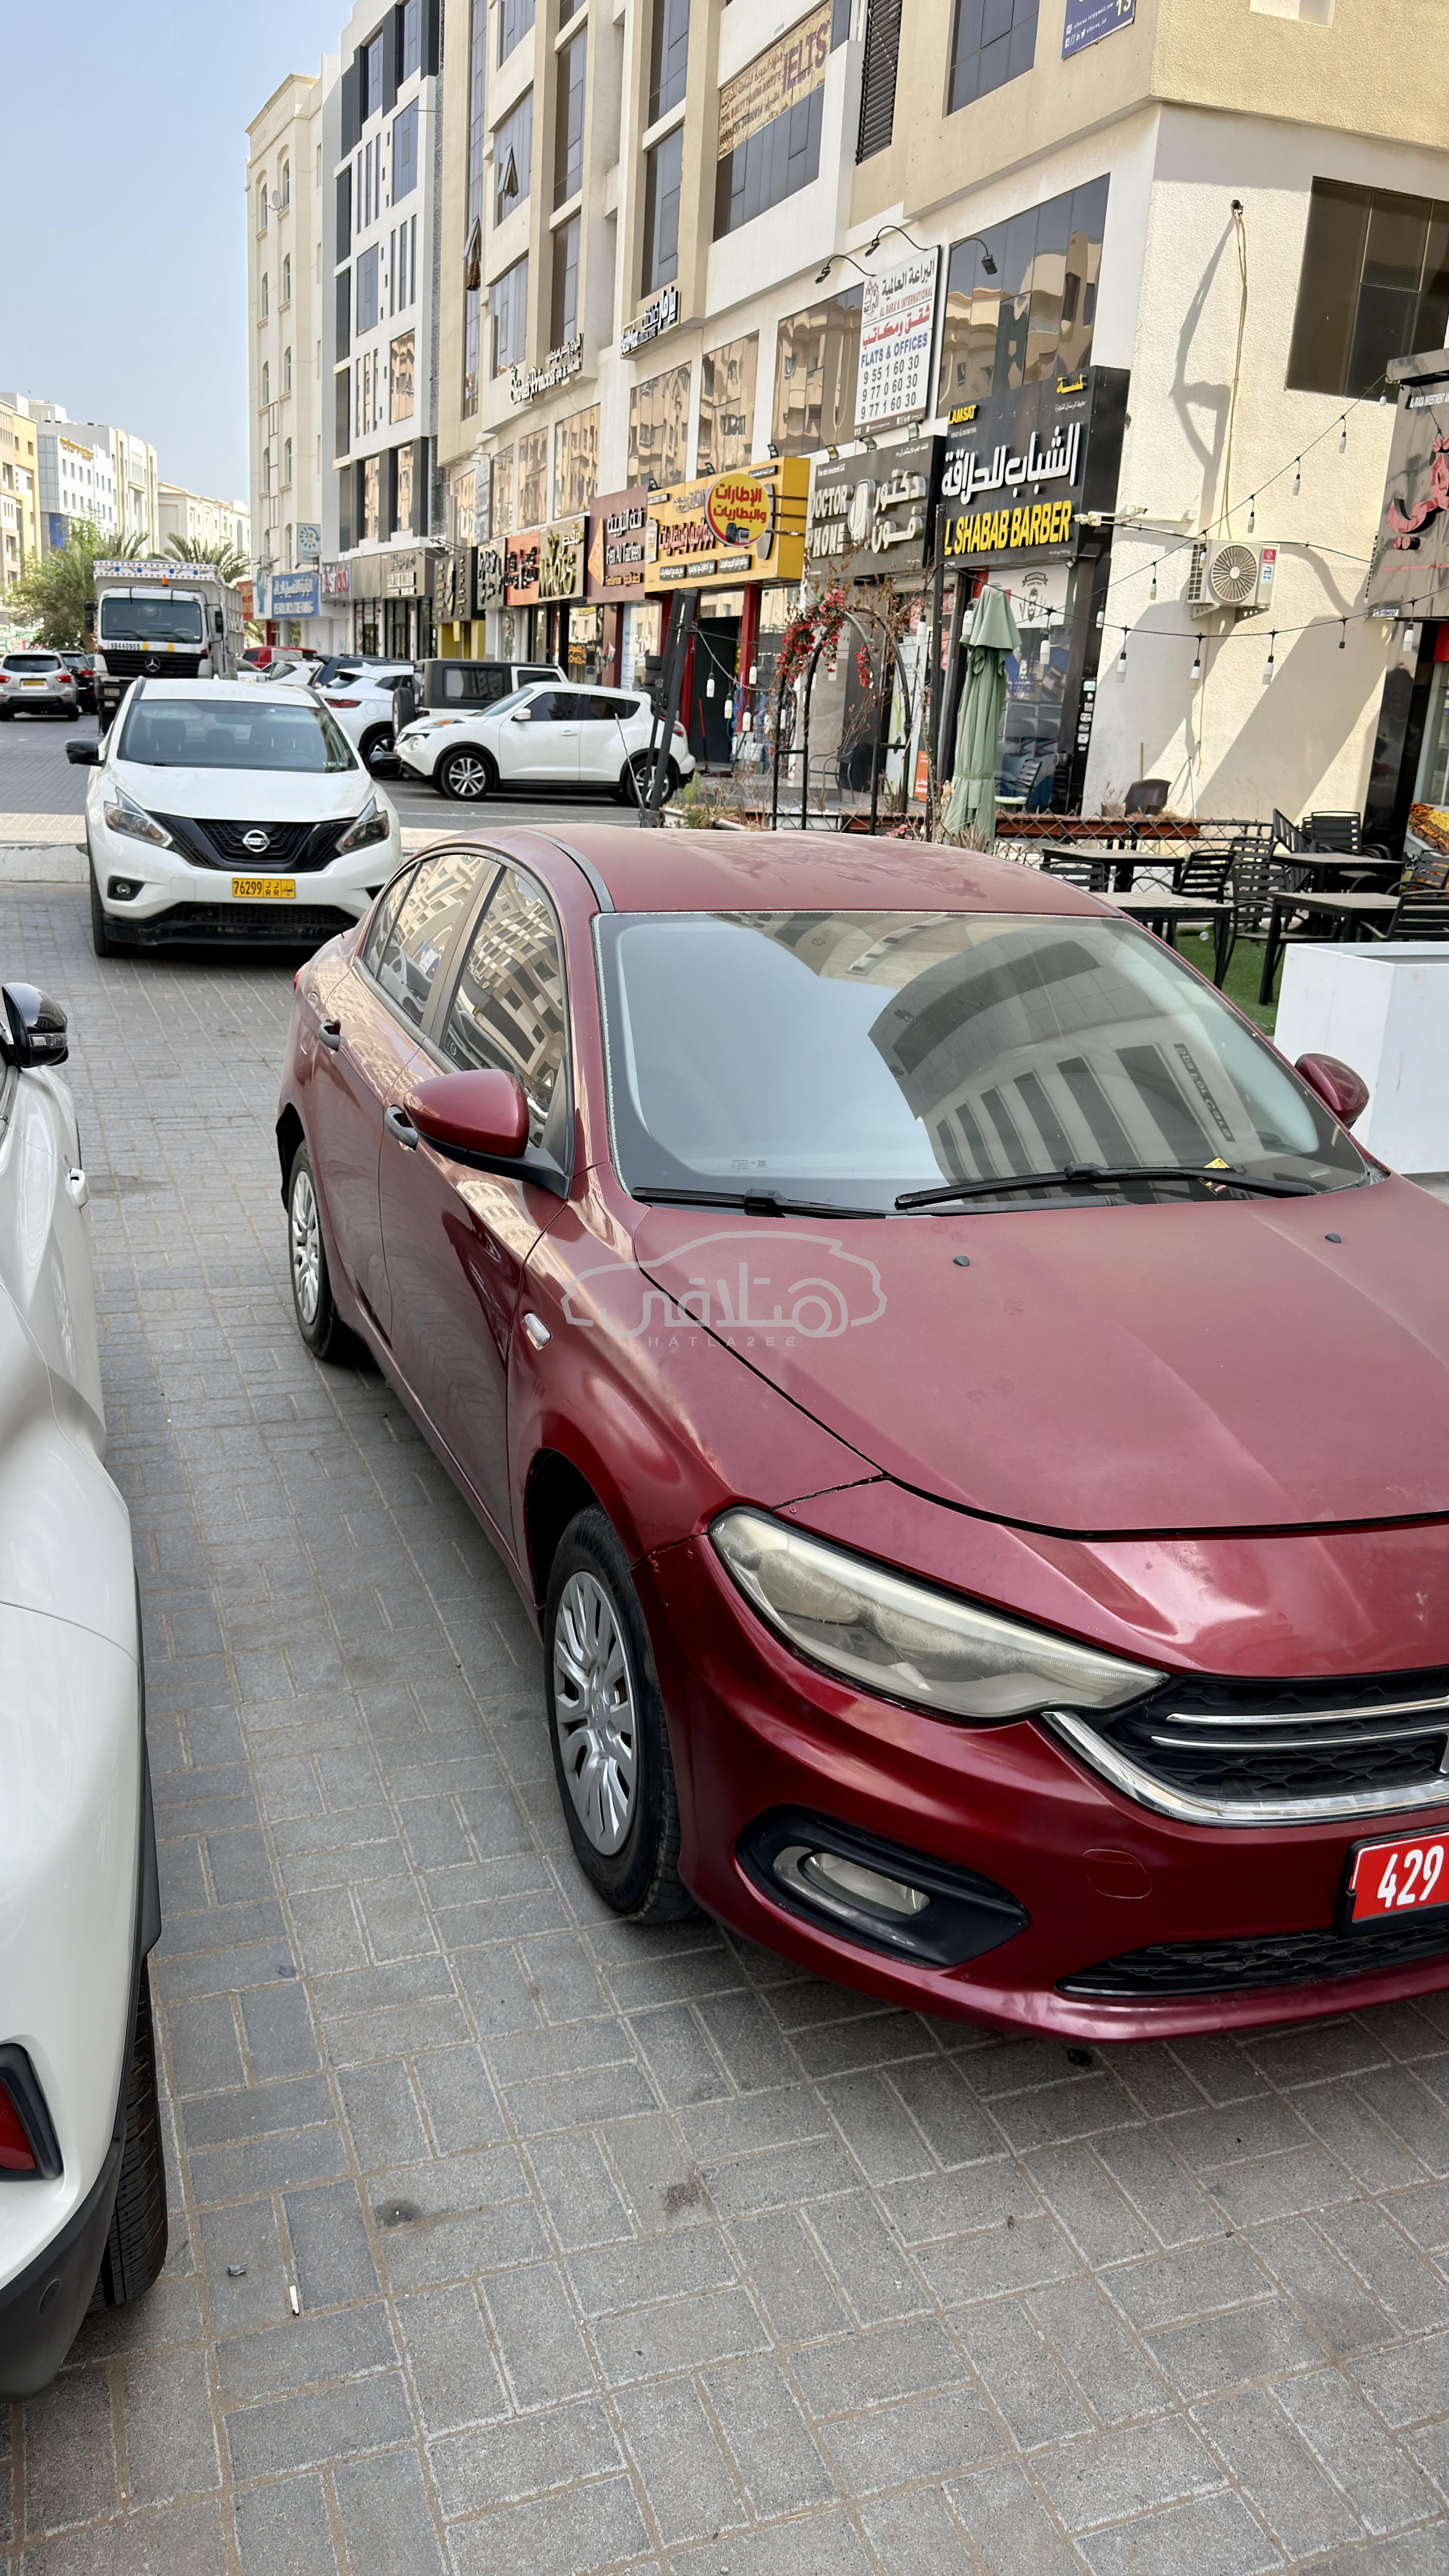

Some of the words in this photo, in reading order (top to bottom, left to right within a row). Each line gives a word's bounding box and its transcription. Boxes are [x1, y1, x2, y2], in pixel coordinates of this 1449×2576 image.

[781, 22, 829, 95] IELTS
[901, 285, 933, 309] INTERNATIONAL
[905, 304, 930, 334] شقق
[861, 348, 884, 368] FLATS
[886, 345, 891, 359] &
[894, 332, 928, 357] OFFICES
[863, 321, 903, 350] ومكاتب
[864, 372, 868, 385] 9
[872, 367, 882, 382] 55
[886, 364, 889, 377] 1
[894, 359, 904, 375] 60
[908, 354, 919, 371] 30
[1056, 373, 1085, 393] لمسة
[862, 389, 867, 402] 9
[871, 385, 881, 400] 77
[884, 382, 888, 395] 0
[892, 378, 902, 393] 60
[907, 373, 917, 389] 30
[1425, 393, 1445, 407] INVESTMENT
[861, 407, 865, 419] 9
[869, 402, 879, 417] 77
[883, 400, 887, 413] 1
[891, 396, 901, 411] 60
[905, 392, 916, 407] 30
[948, 404, 976, 425] LAMSAT
[942, 445, 1007, 505] للحلاقة
[1005, 422, 1080, 498] الشباب
[716, 484, 762, 506] الإطارات
[807, 484, 852, 519] DOCTOR
[872, 468, 926, 515] دكتور
[713, 505, 767, 524] والبطاريات
[954, 510, 1009, 555] SHABAB
[1010, 500, 1072, 547] BARBER
[805, 523, 850, 557] PHONE
[871, 506, 923, 554] فون
[234, 881, 262, 895] 76299
[1377, 1845, 1444, 1908] 429
